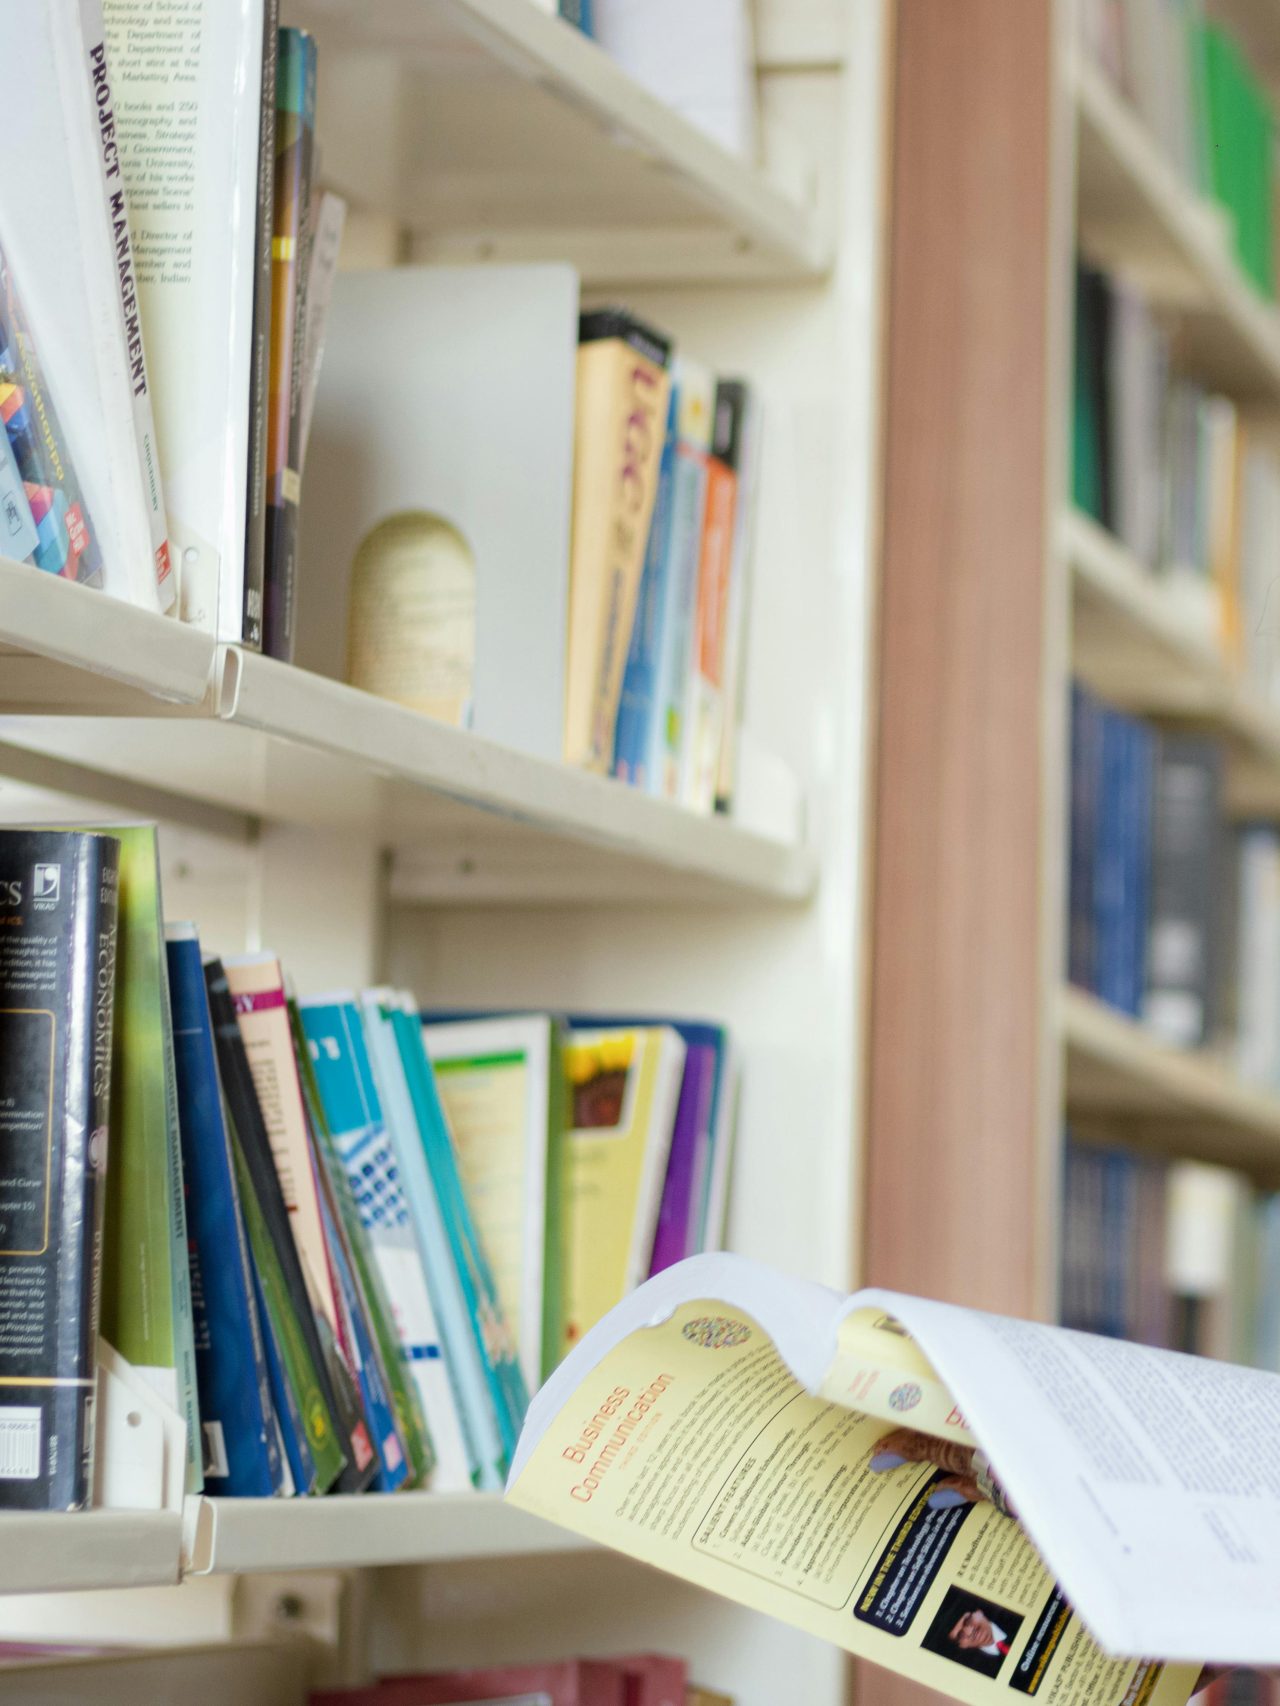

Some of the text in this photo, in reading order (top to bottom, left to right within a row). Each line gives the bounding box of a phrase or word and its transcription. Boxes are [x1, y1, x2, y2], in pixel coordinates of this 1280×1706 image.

[122, 72, 168, 83] Marketing
[127, 30, 183, 41] Department
[127, 44, 183, 55] Department
[117, 116, 173, 128] emography
[88, 40, 147, 398] PROJECT MANAGEMENT
[92, 932, 109, 1097] ECONOMICS
[170, 1130, 182, 1239] MANAGEMENT
[561, 1382, 630, 1466] Business
[568, 1370, 674, 1505] Communication
[698, 1455, 756, 1545] SALIENT FEATURES
[1019, 1599, 1060, 1672] Online resources
